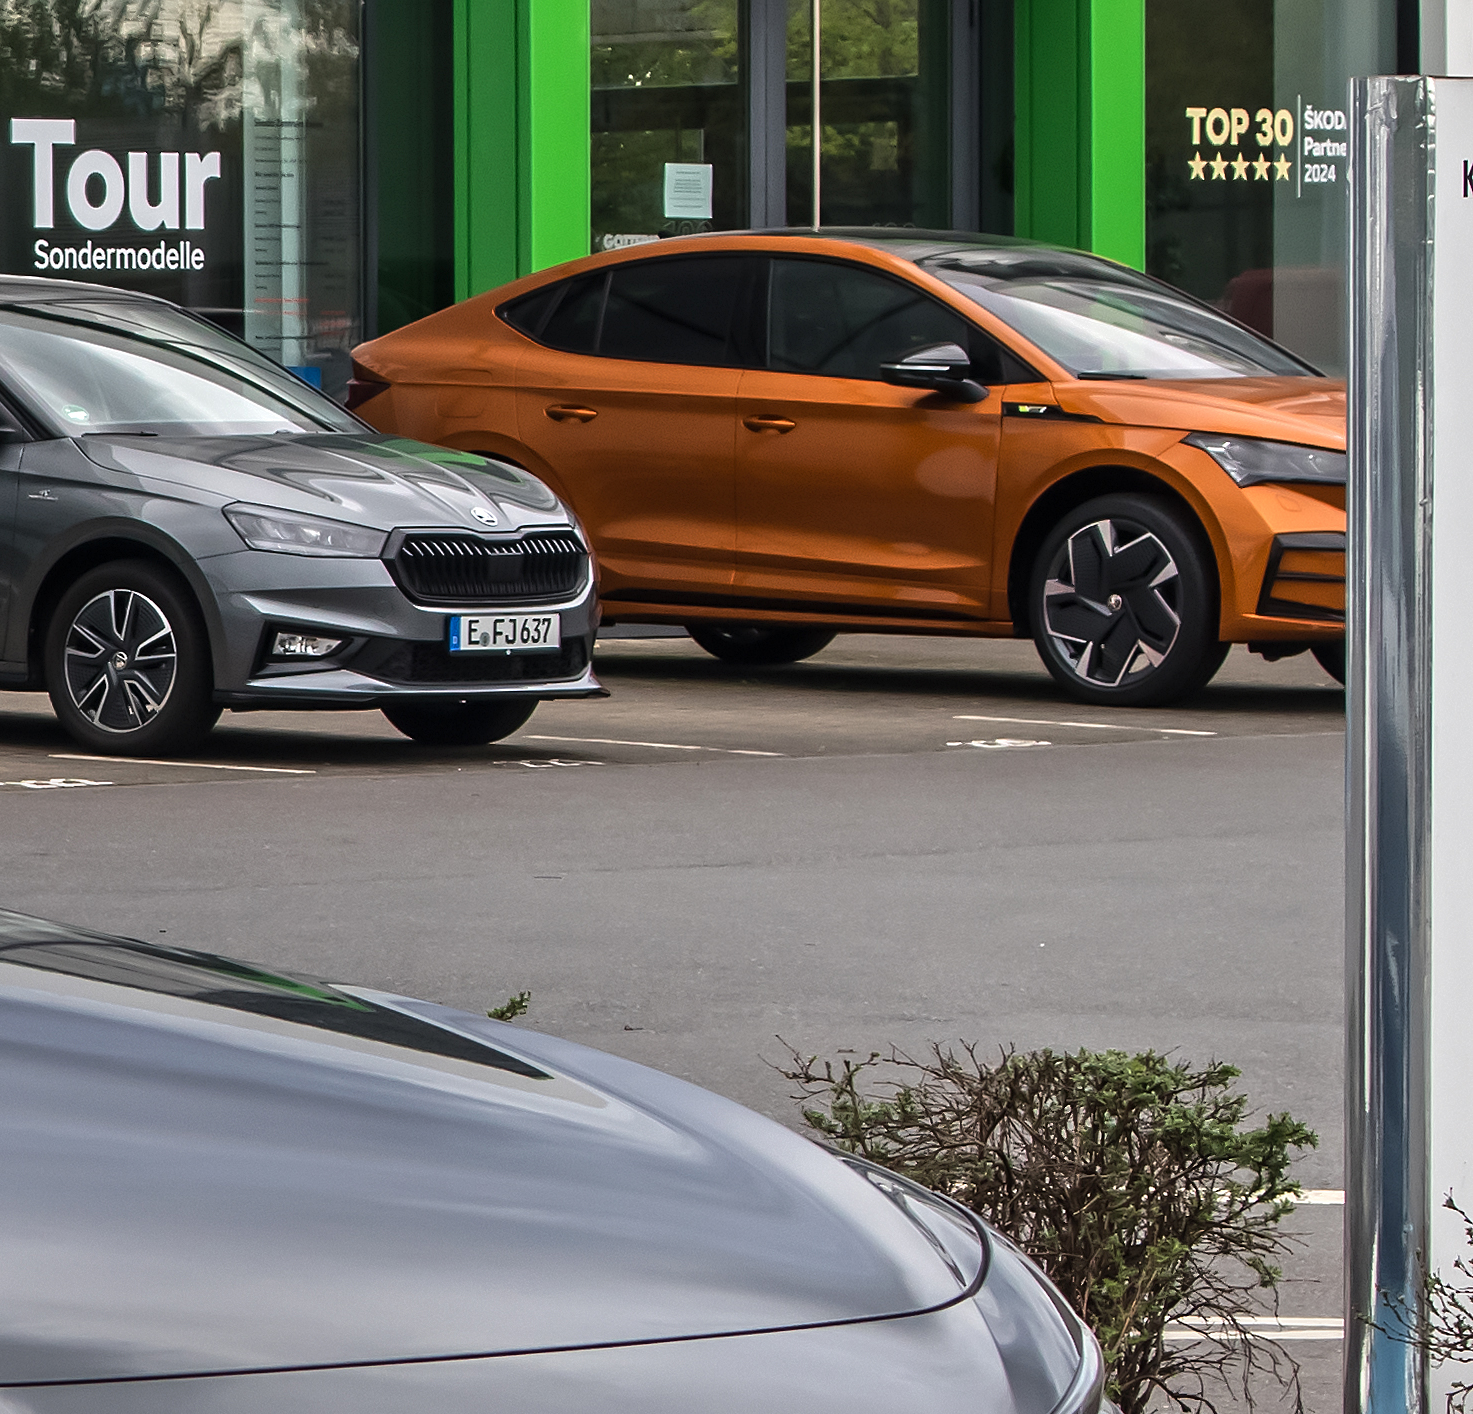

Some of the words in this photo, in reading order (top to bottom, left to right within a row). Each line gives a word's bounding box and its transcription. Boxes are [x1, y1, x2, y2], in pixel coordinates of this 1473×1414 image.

[1186, 107, 1250, 146] TOP
[1255, 108, 1294, 147] 30
[1304, 104, 1347, 130] ŠKOD
[1304, 136, 1347, 158] Partne
[11, 118, 221, 231] Tour
[1304, 164, 1336, 182] 2024
[34, 239, 205, 270] Sondermodelle
[468, 619, 480, 636] E
